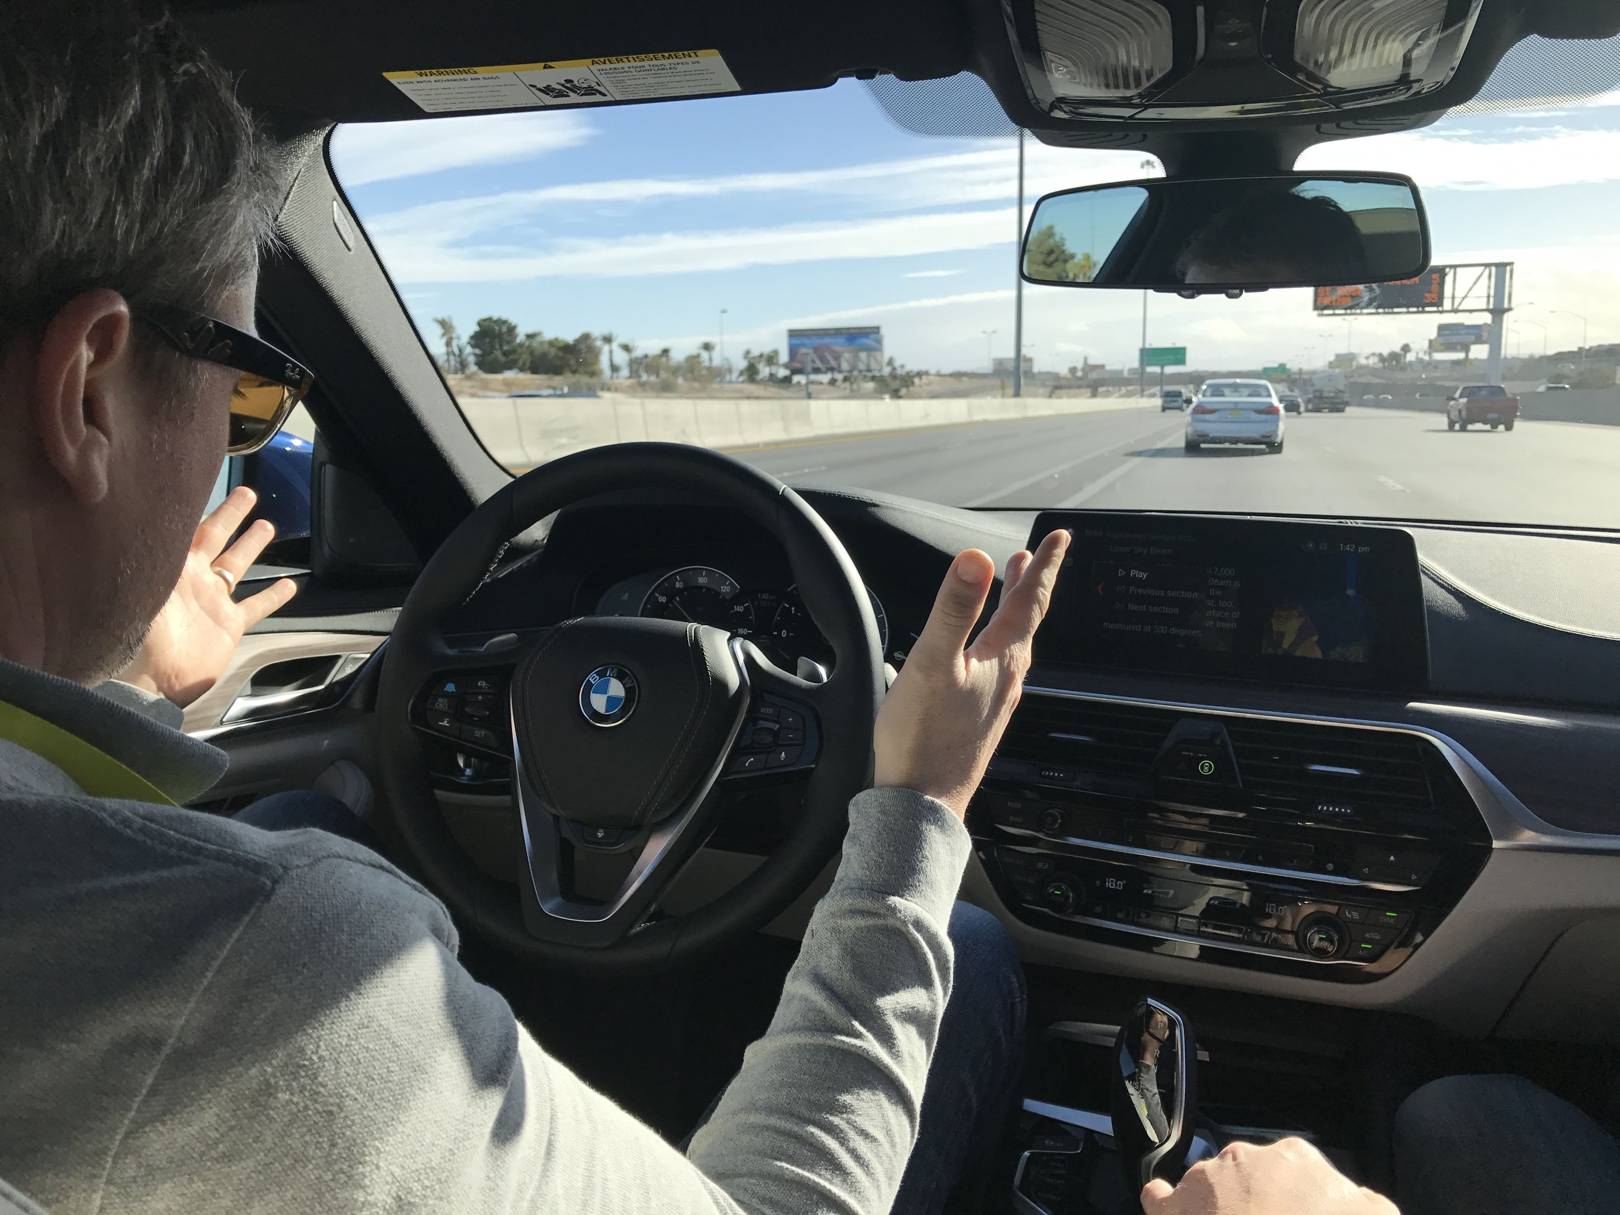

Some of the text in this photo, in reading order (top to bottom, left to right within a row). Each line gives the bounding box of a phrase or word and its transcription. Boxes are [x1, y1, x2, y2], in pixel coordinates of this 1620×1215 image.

[590, 50, 699, 66] AVERTISSEMENT
[415, 68, 478, 78] WARNING
[1340, 543, 1355, 552] 1:42
[1130, 569, 1149, 580] Play
[1129, 586, 1164, 597] Previous
[658, 595, 667, 603] 60
[1148, 605, 1179, 615] section
[781, 629, 787, 638] 0
[588, 666, 635, 688] BMW
